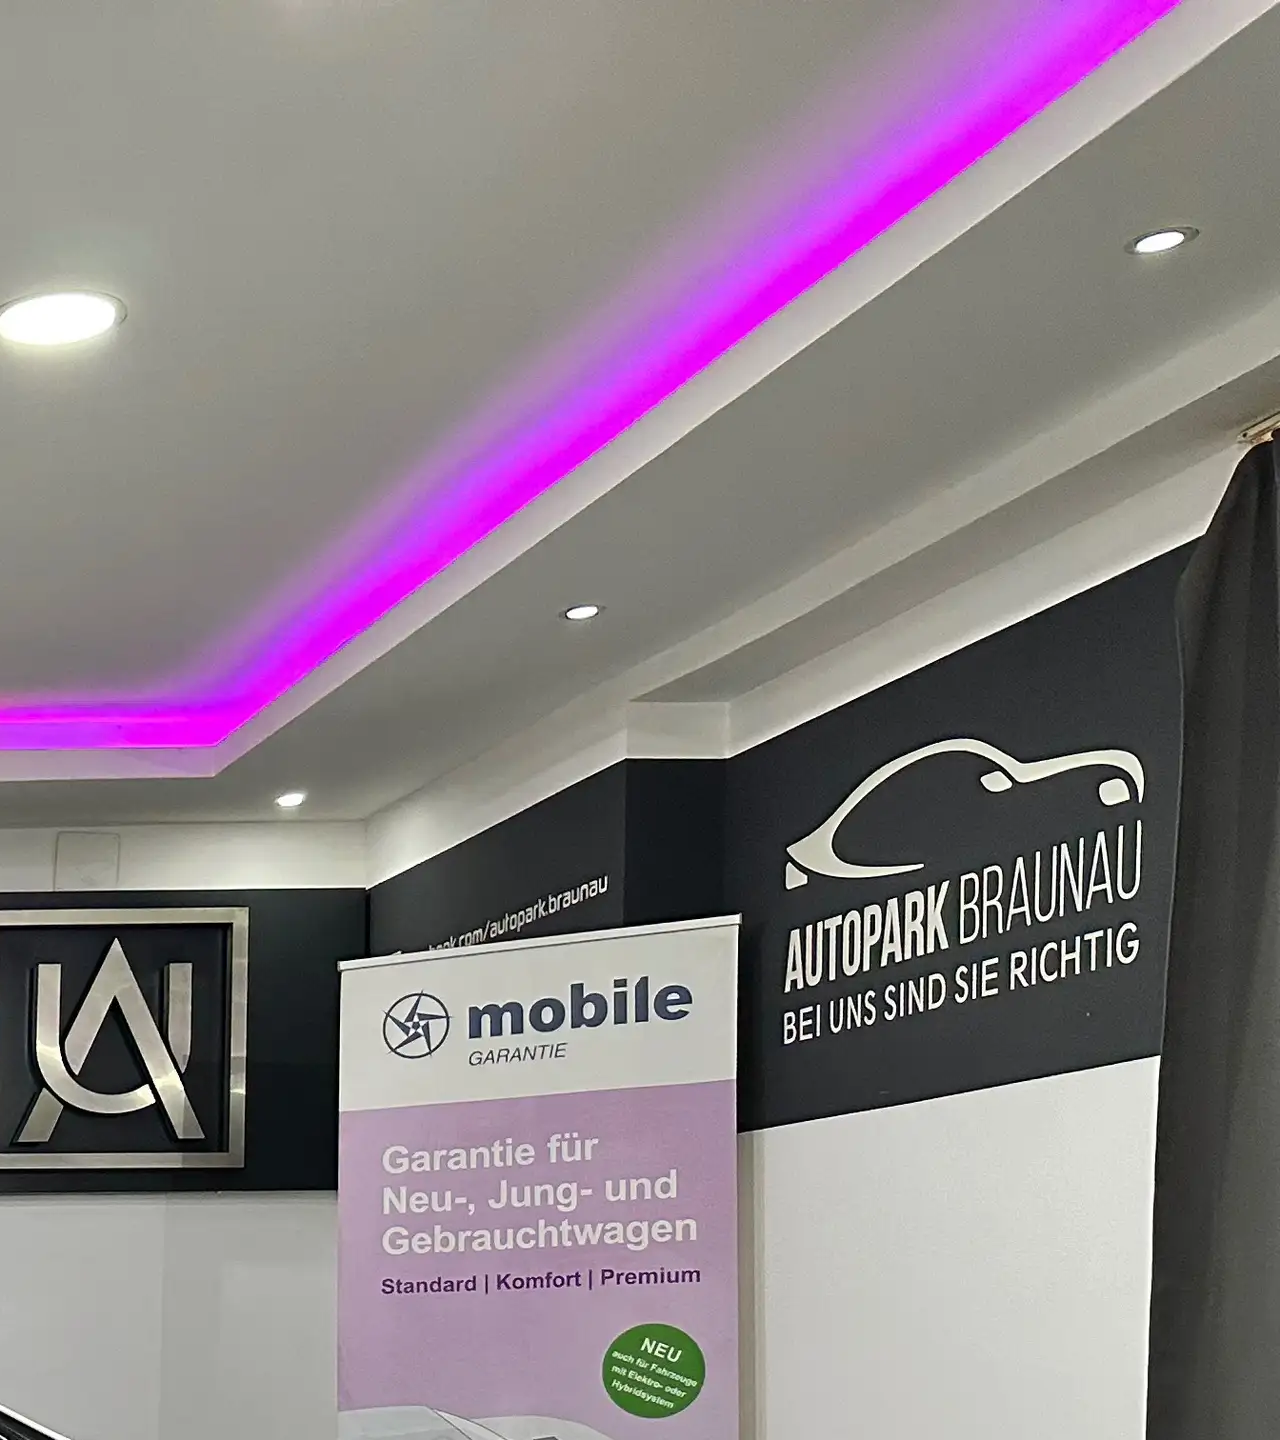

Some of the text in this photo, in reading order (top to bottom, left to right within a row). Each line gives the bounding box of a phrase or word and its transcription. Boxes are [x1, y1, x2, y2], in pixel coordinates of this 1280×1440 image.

[783, 819, 1143, 994] AUTOPARK BRAUNAU
[783, 922, 1140, 1045] BEI UNS SIND SIE RICHTIG
[468, 975, 693, 1040] mobile
[468, 1042, 568, 1067] GARANTIE
[382, 1132, 599, 1174] Garantie für
[383, 1169, 677, 1216] Neu-, Jung- und
[382, 1218, 697, 1255] Gebrauchtwagen
[381, 1275, 477, 1295] Standard
[496, 1271, 582, 1291] Komfort
[601, 1268, 701, 1286] Premium
[640, 1337, 683, 1363] NEU
[611, 1350, 698, 1388] auch für Fahrzeuge
[611, 1365, 628, 1376] mit
[664, 1385, 687, 1398] oder
[611, 1378, 674, 1409] Hybridsystem
